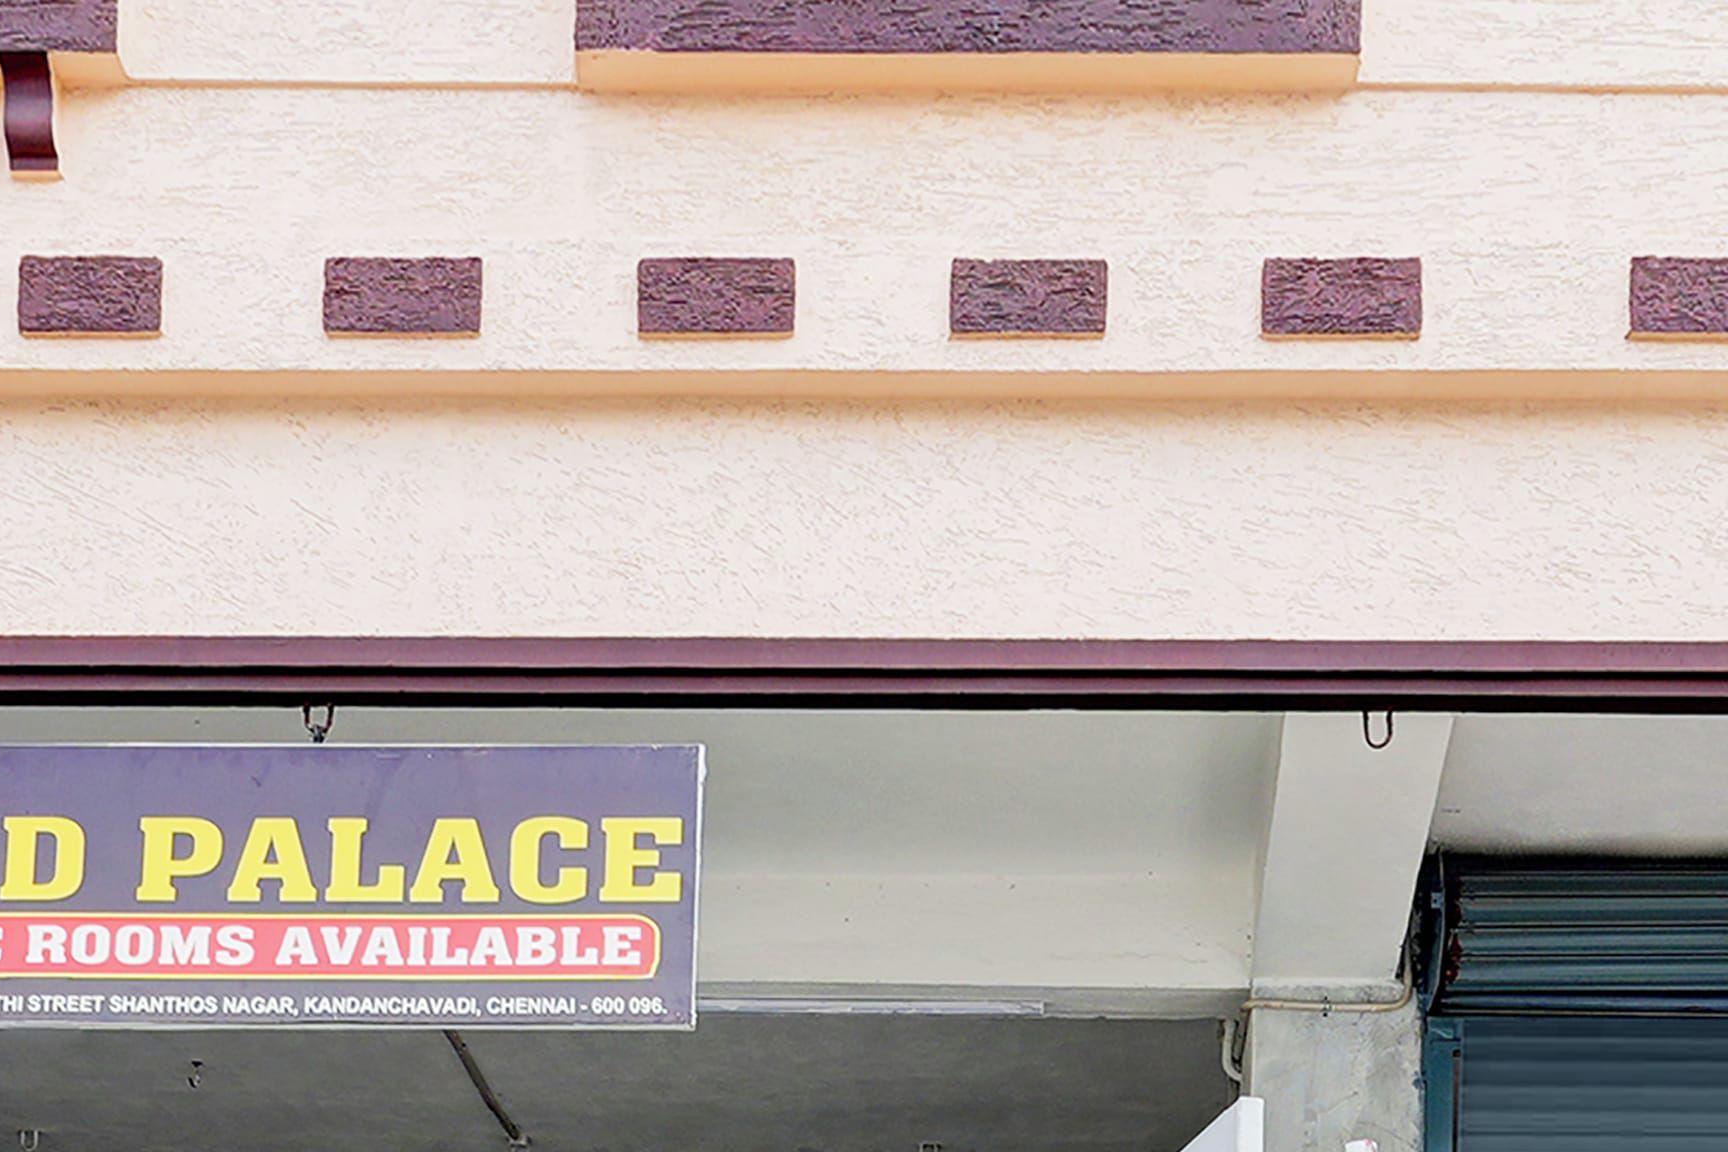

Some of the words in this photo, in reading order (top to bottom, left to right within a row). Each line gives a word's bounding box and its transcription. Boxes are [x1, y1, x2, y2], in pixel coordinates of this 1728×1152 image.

[135, 815, 684, 904] PALACE
[26, 924, 255, 966] ROOMS
[275, 925, 642, 967] AVAILABLE
[27, 994, 105, 1013] STREET
[109, 994, 218, 1014] SHANTHOS
[222, 996, 299, 1016] NAGAR,
[304, 996, 482, 1016] KANDANCHAVADI,
[486, 996, 576, 1015] CHENNAI
[591, 996, 625, 1015] 600
[628, 996, 668, 1015] 096.
